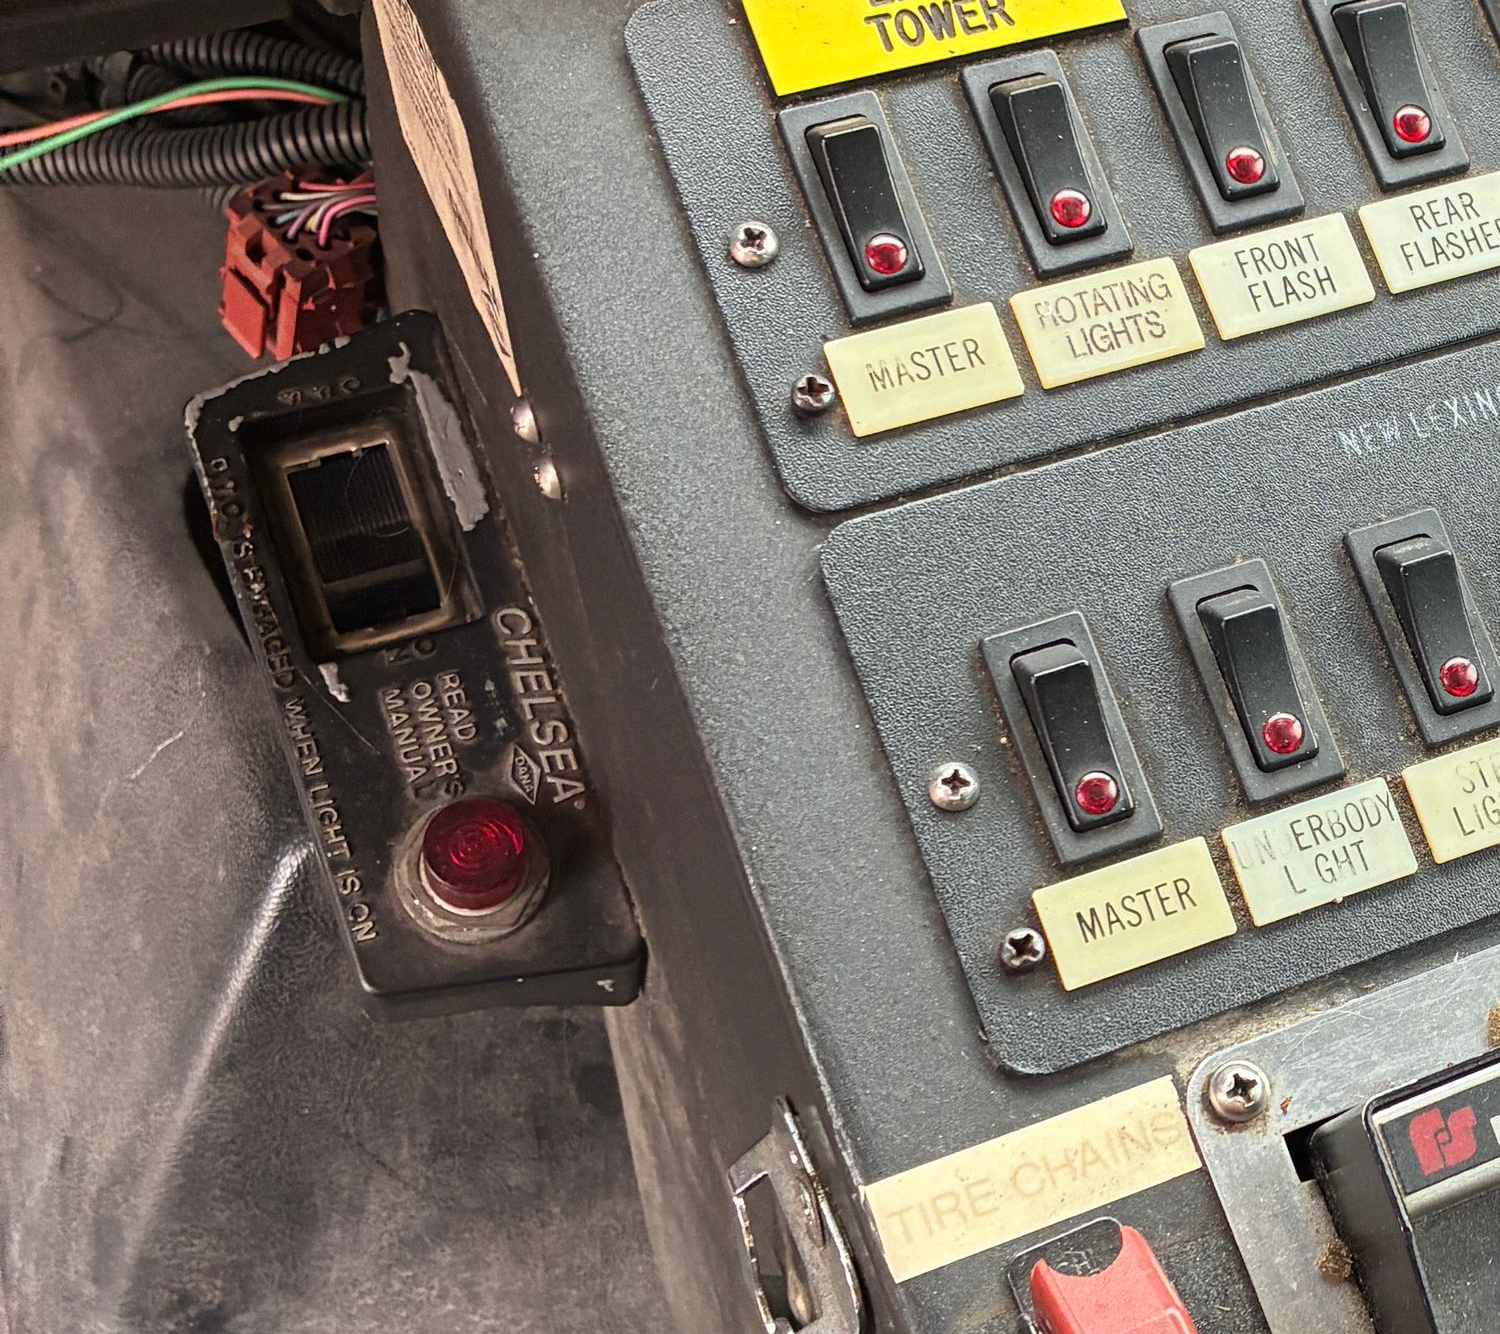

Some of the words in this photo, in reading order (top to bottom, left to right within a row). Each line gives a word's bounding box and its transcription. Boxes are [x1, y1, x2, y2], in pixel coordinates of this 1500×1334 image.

[1408, 190, 1481, 233] REAR
[1234, 232, 1322, 279] FRONT
[1034, 272, 1173, 330] ROTATING
[1247, 263, 1338, 313] FLASH
[1065, 309, 1167, 360] LIGHTS
[866, 336, 987, 394] MASTER
[1336, 416, 1402, 457] NEW
[440, 672, 478, 742] READ
[497, 607, 586, 805] CHELSEA
[284, 698, 325, 778] WHEN
[383, 688, 431, 799] MANUAL
[412, 681, 466, 798] OWNER'S
[514, 754, 534, 794] DANA
[308, 783, 352, 860] LIGHT
[336, 868, 362, 896] IS
[1283, 838, 1370, 896] LGHT
[347, 902, 378, 944] ON
[1074, 875, 1199, 945] MASTER
[885, 1176, 1002, 1245] TIRE
[1010, 1109, 1186, 1199] CHAINS
